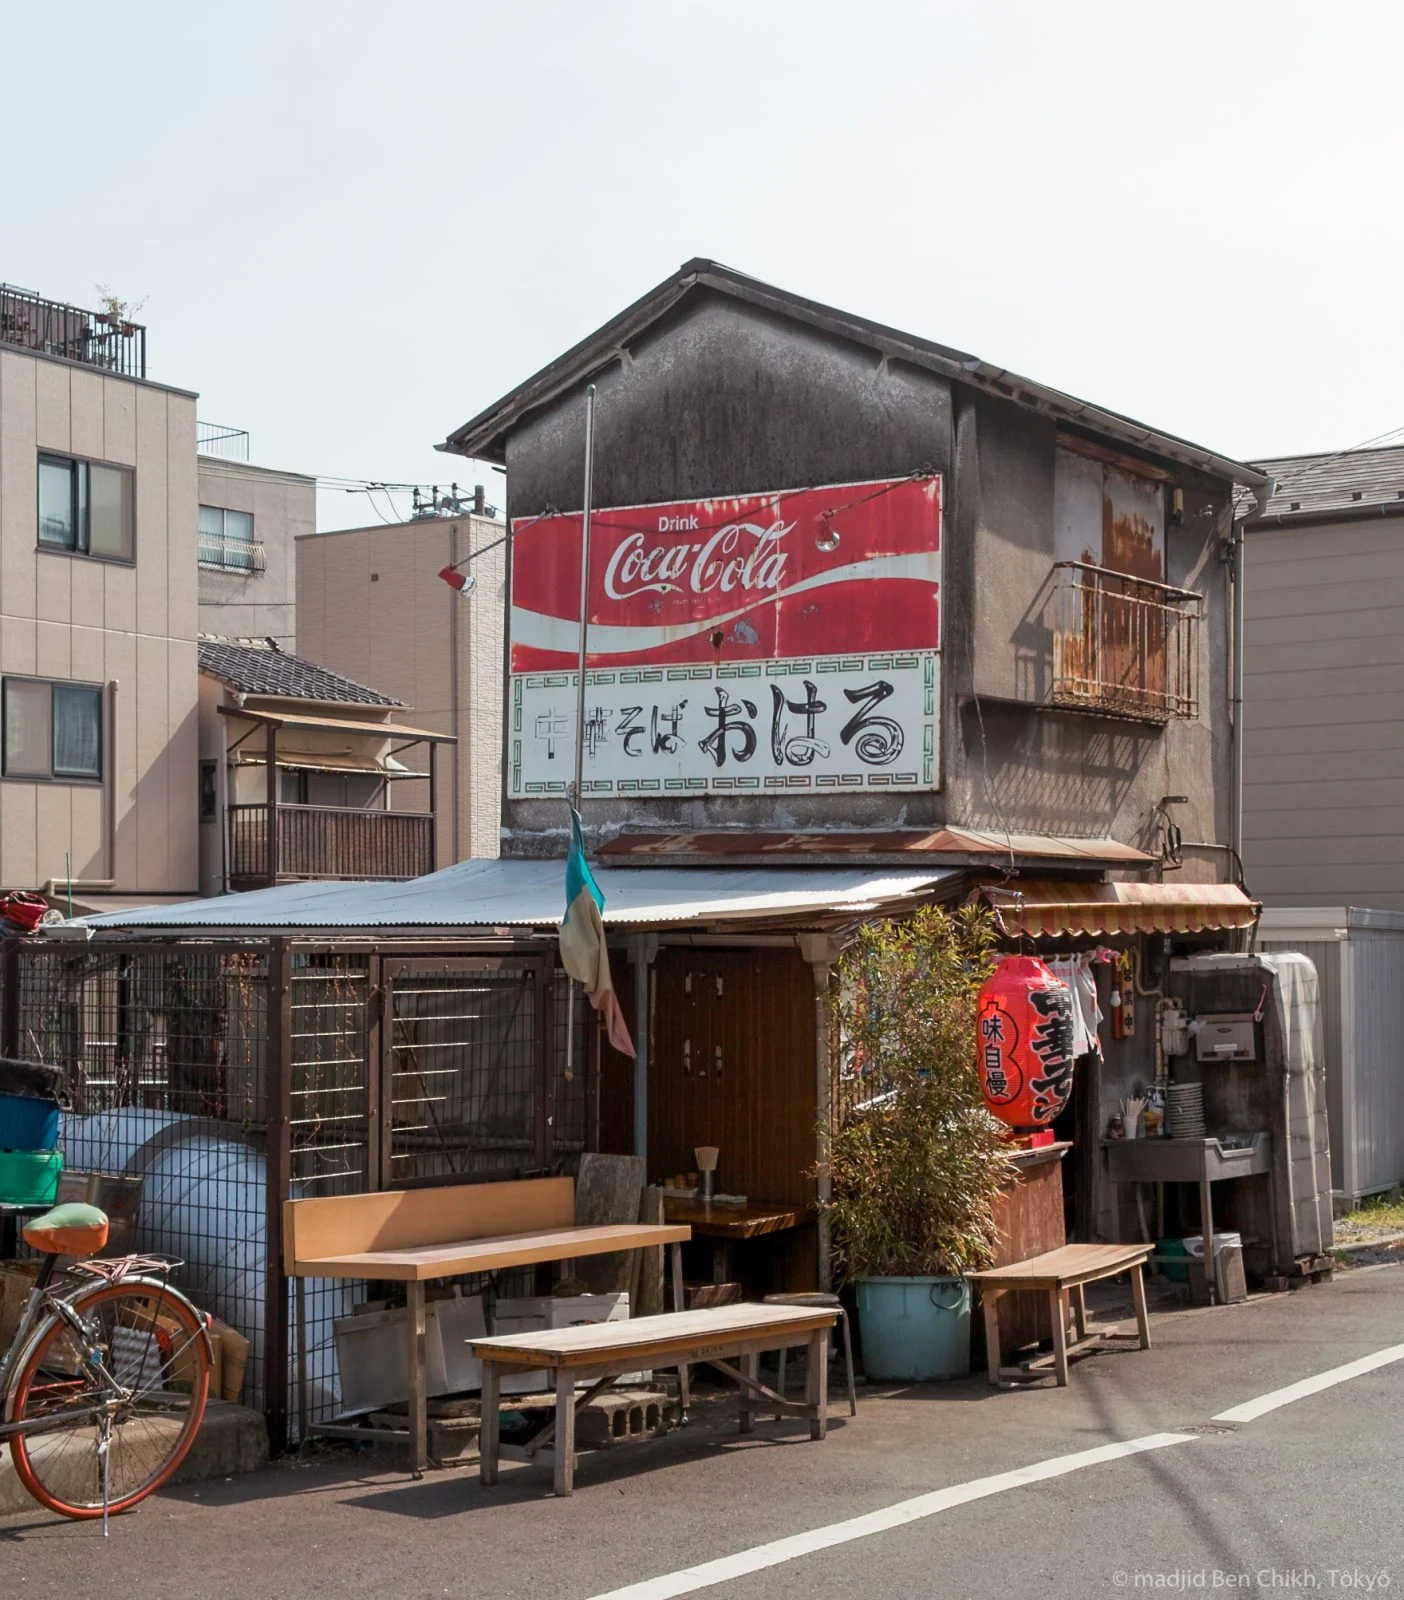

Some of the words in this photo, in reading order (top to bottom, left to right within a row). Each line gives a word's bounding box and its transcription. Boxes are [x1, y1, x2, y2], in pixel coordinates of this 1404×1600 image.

[604, 519, 798, 600] Coca-Cola
[658, 514, 699, 533] Drink
[697, 679, 905, 768] おはる
[982, 1014, 1010, 1098] 味自慢
